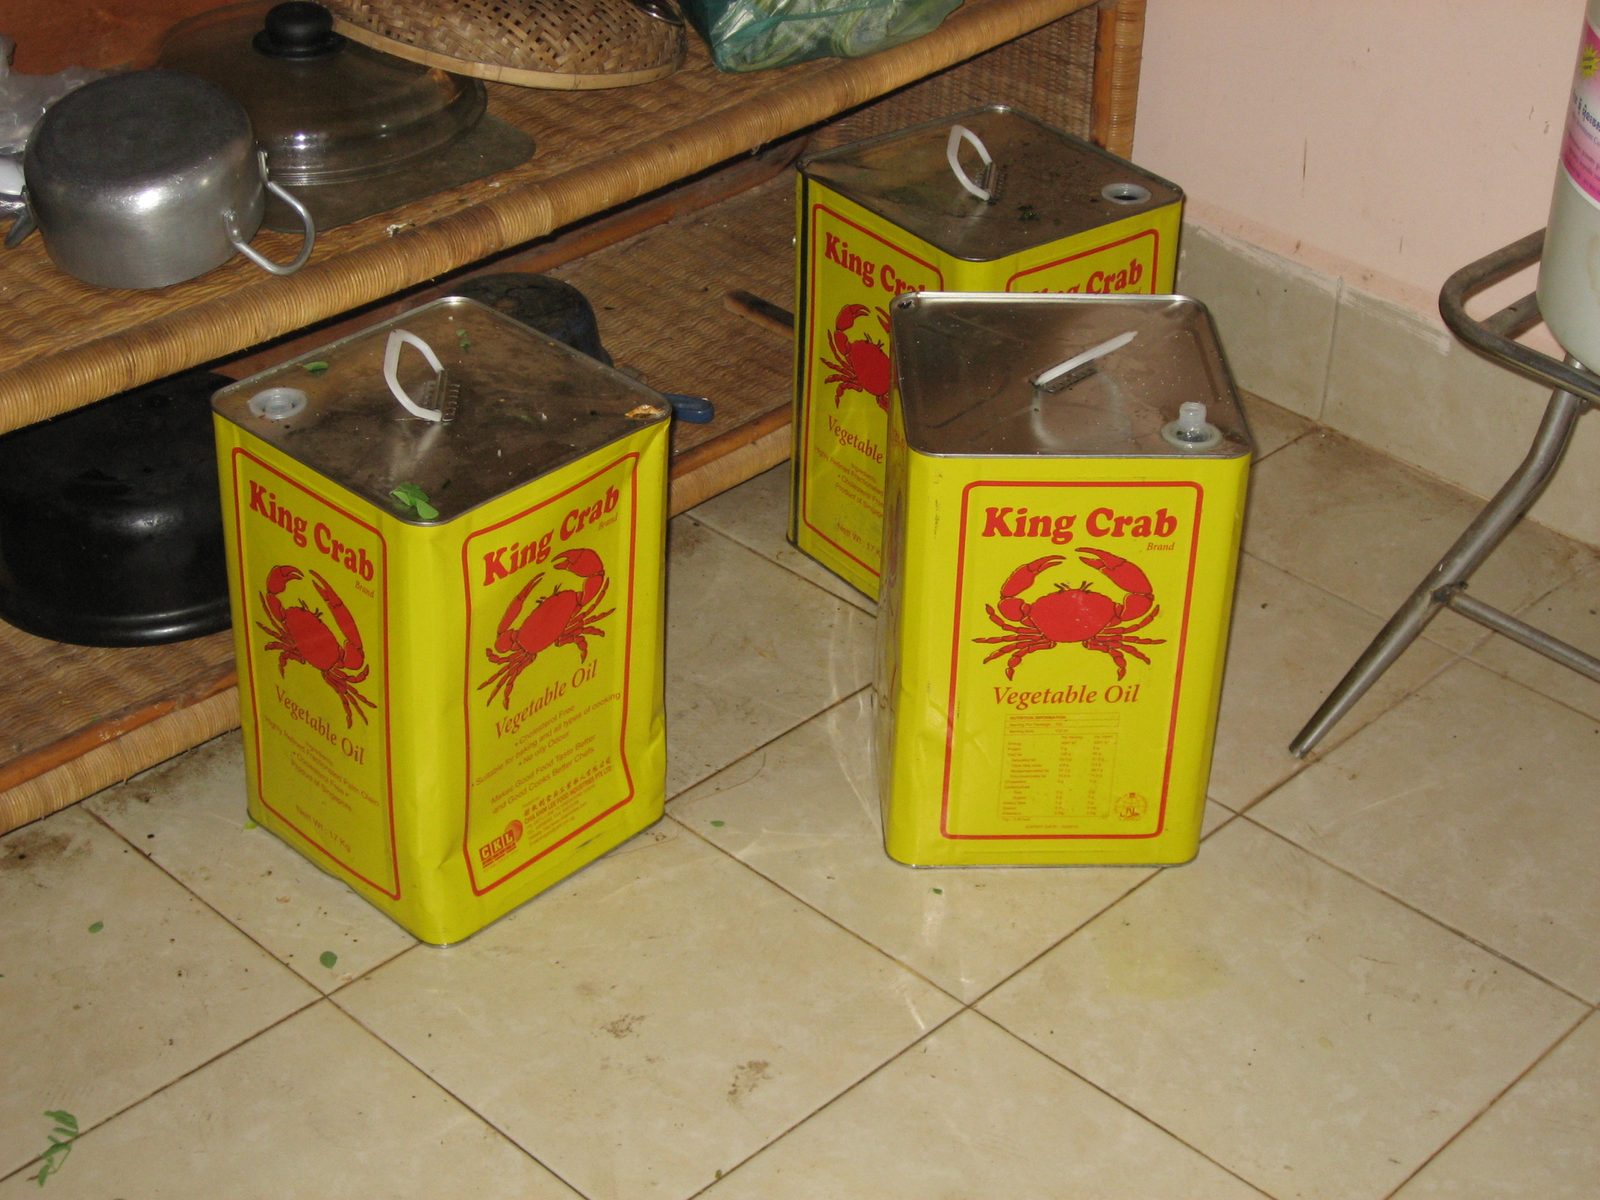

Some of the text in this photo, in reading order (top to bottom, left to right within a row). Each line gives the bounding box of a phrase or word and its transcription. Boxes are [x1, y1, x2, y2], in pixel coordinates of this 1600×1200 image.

[825, 232, 925, 296] King Cr
[1086, 258, 1143, 294] Crab
[828, 414, 883, 465] Vegetable
[249, 480, 374, 581] King Crab
[482, 485, 620, 586] King Crab
[981, 507, 1178, 545] King Crab
[1146, 541, 1176, 552] Brand
[354, 581, 375, 598] Brand
[495, 658, 597, 738] Vegetable Oil
[993, 684, 1140, 711] Vegetable Oil
[274, 685, 337, 746] Vegetable
[341, 737, 365, 765] Oil
[480, 831, 515, 860] CKL
